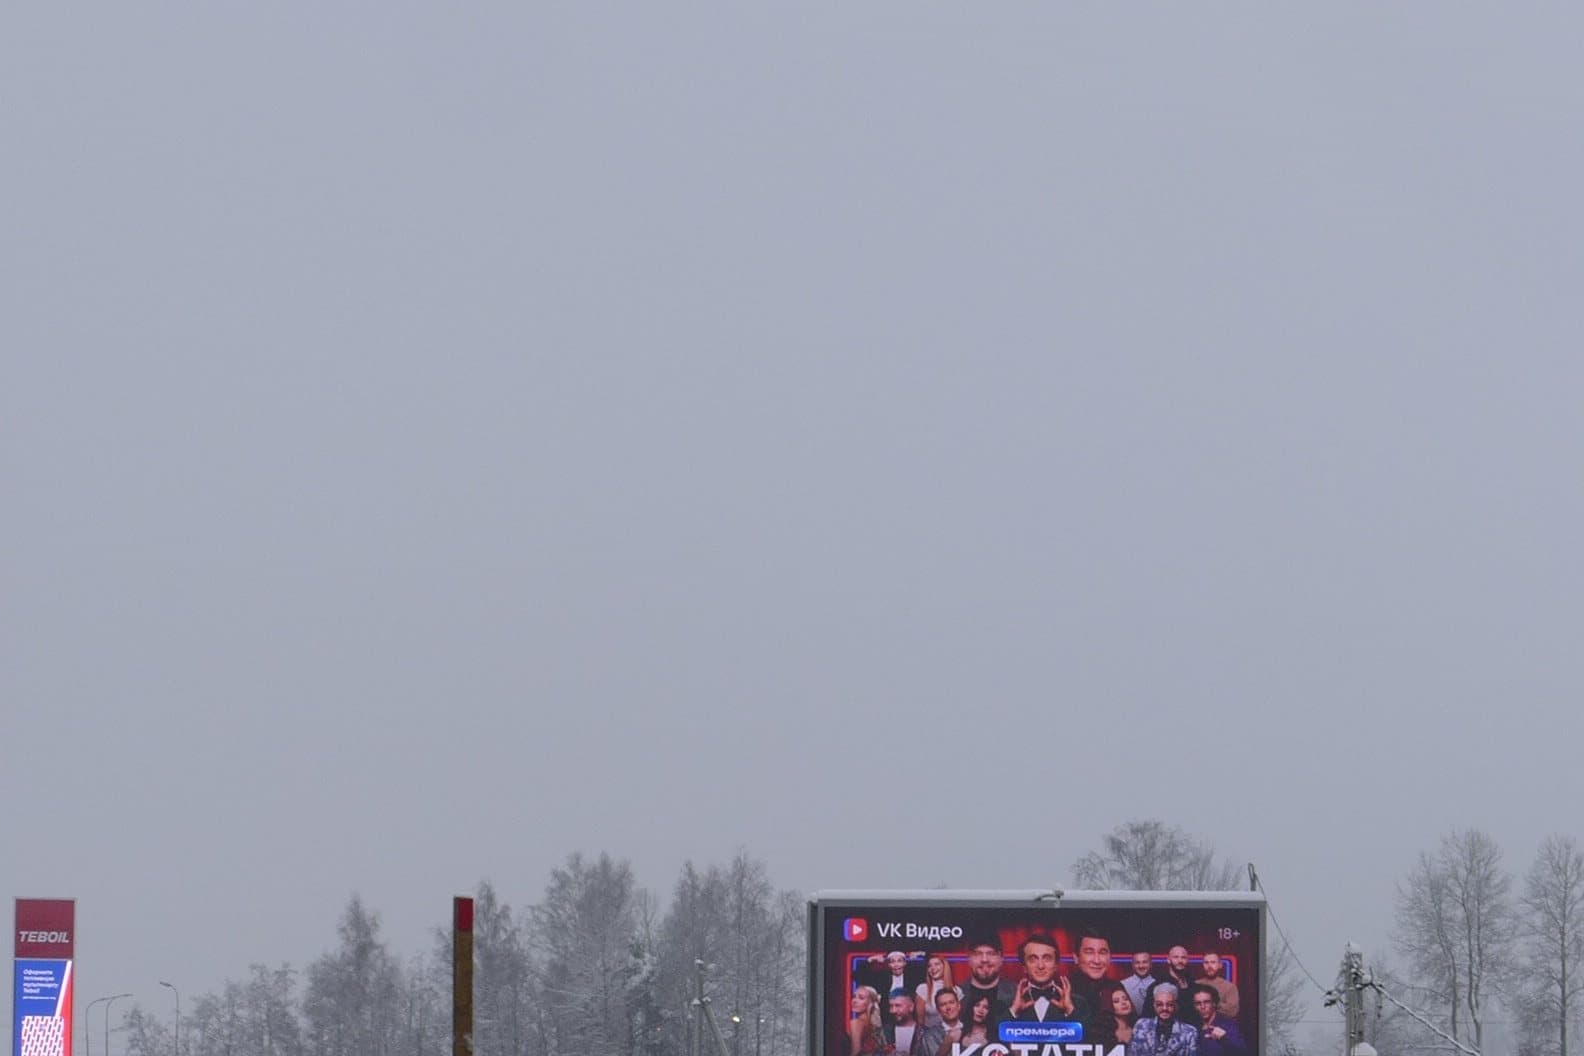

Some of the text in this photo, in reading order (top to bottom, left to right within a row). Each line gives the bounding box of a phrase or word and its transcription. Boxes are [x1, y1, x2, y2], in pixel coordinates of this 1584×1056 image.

[19, 931, 69, 943] TEBOIL
[877, 923, 963, 940] VK Видео
[1217, 928, 1241, 940] 18+
[1005, 1027, 1076, 1037] премьера
